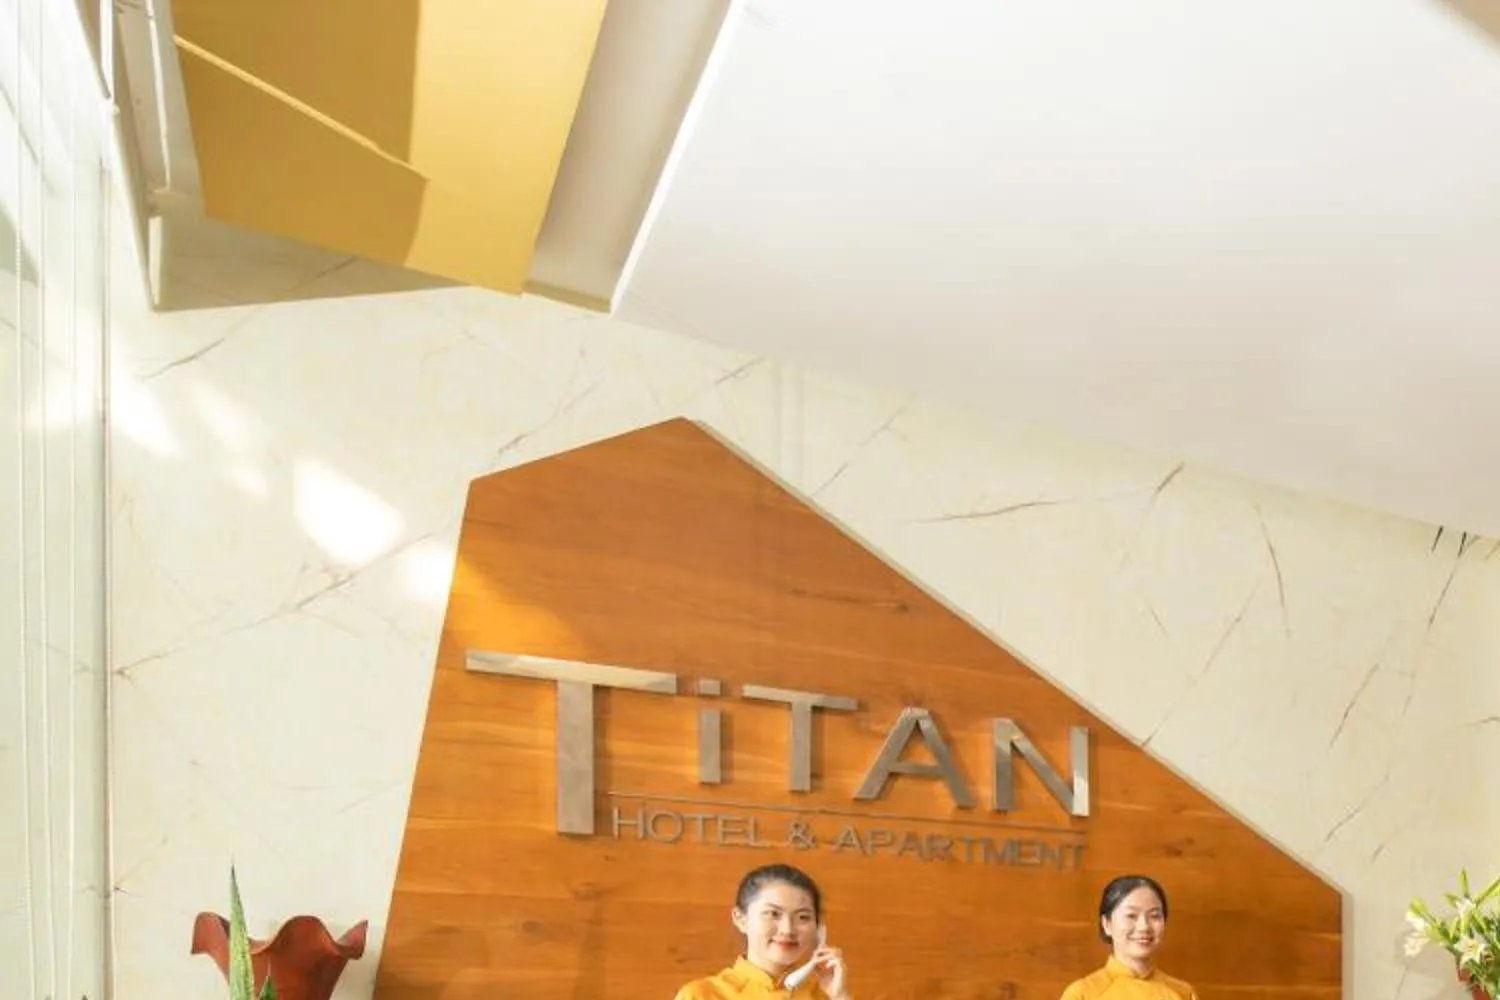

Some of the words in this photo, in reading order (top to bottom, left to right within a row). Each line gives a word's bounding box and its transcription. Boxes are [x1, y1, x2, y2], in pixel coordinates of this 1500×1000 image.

[465, 649, 1089, 837] TiTAN
[611, 806, 771, 849] HOTEL
[789, 818, 817, 851] &
[832, 822, 1089, 874] APARTMENT
